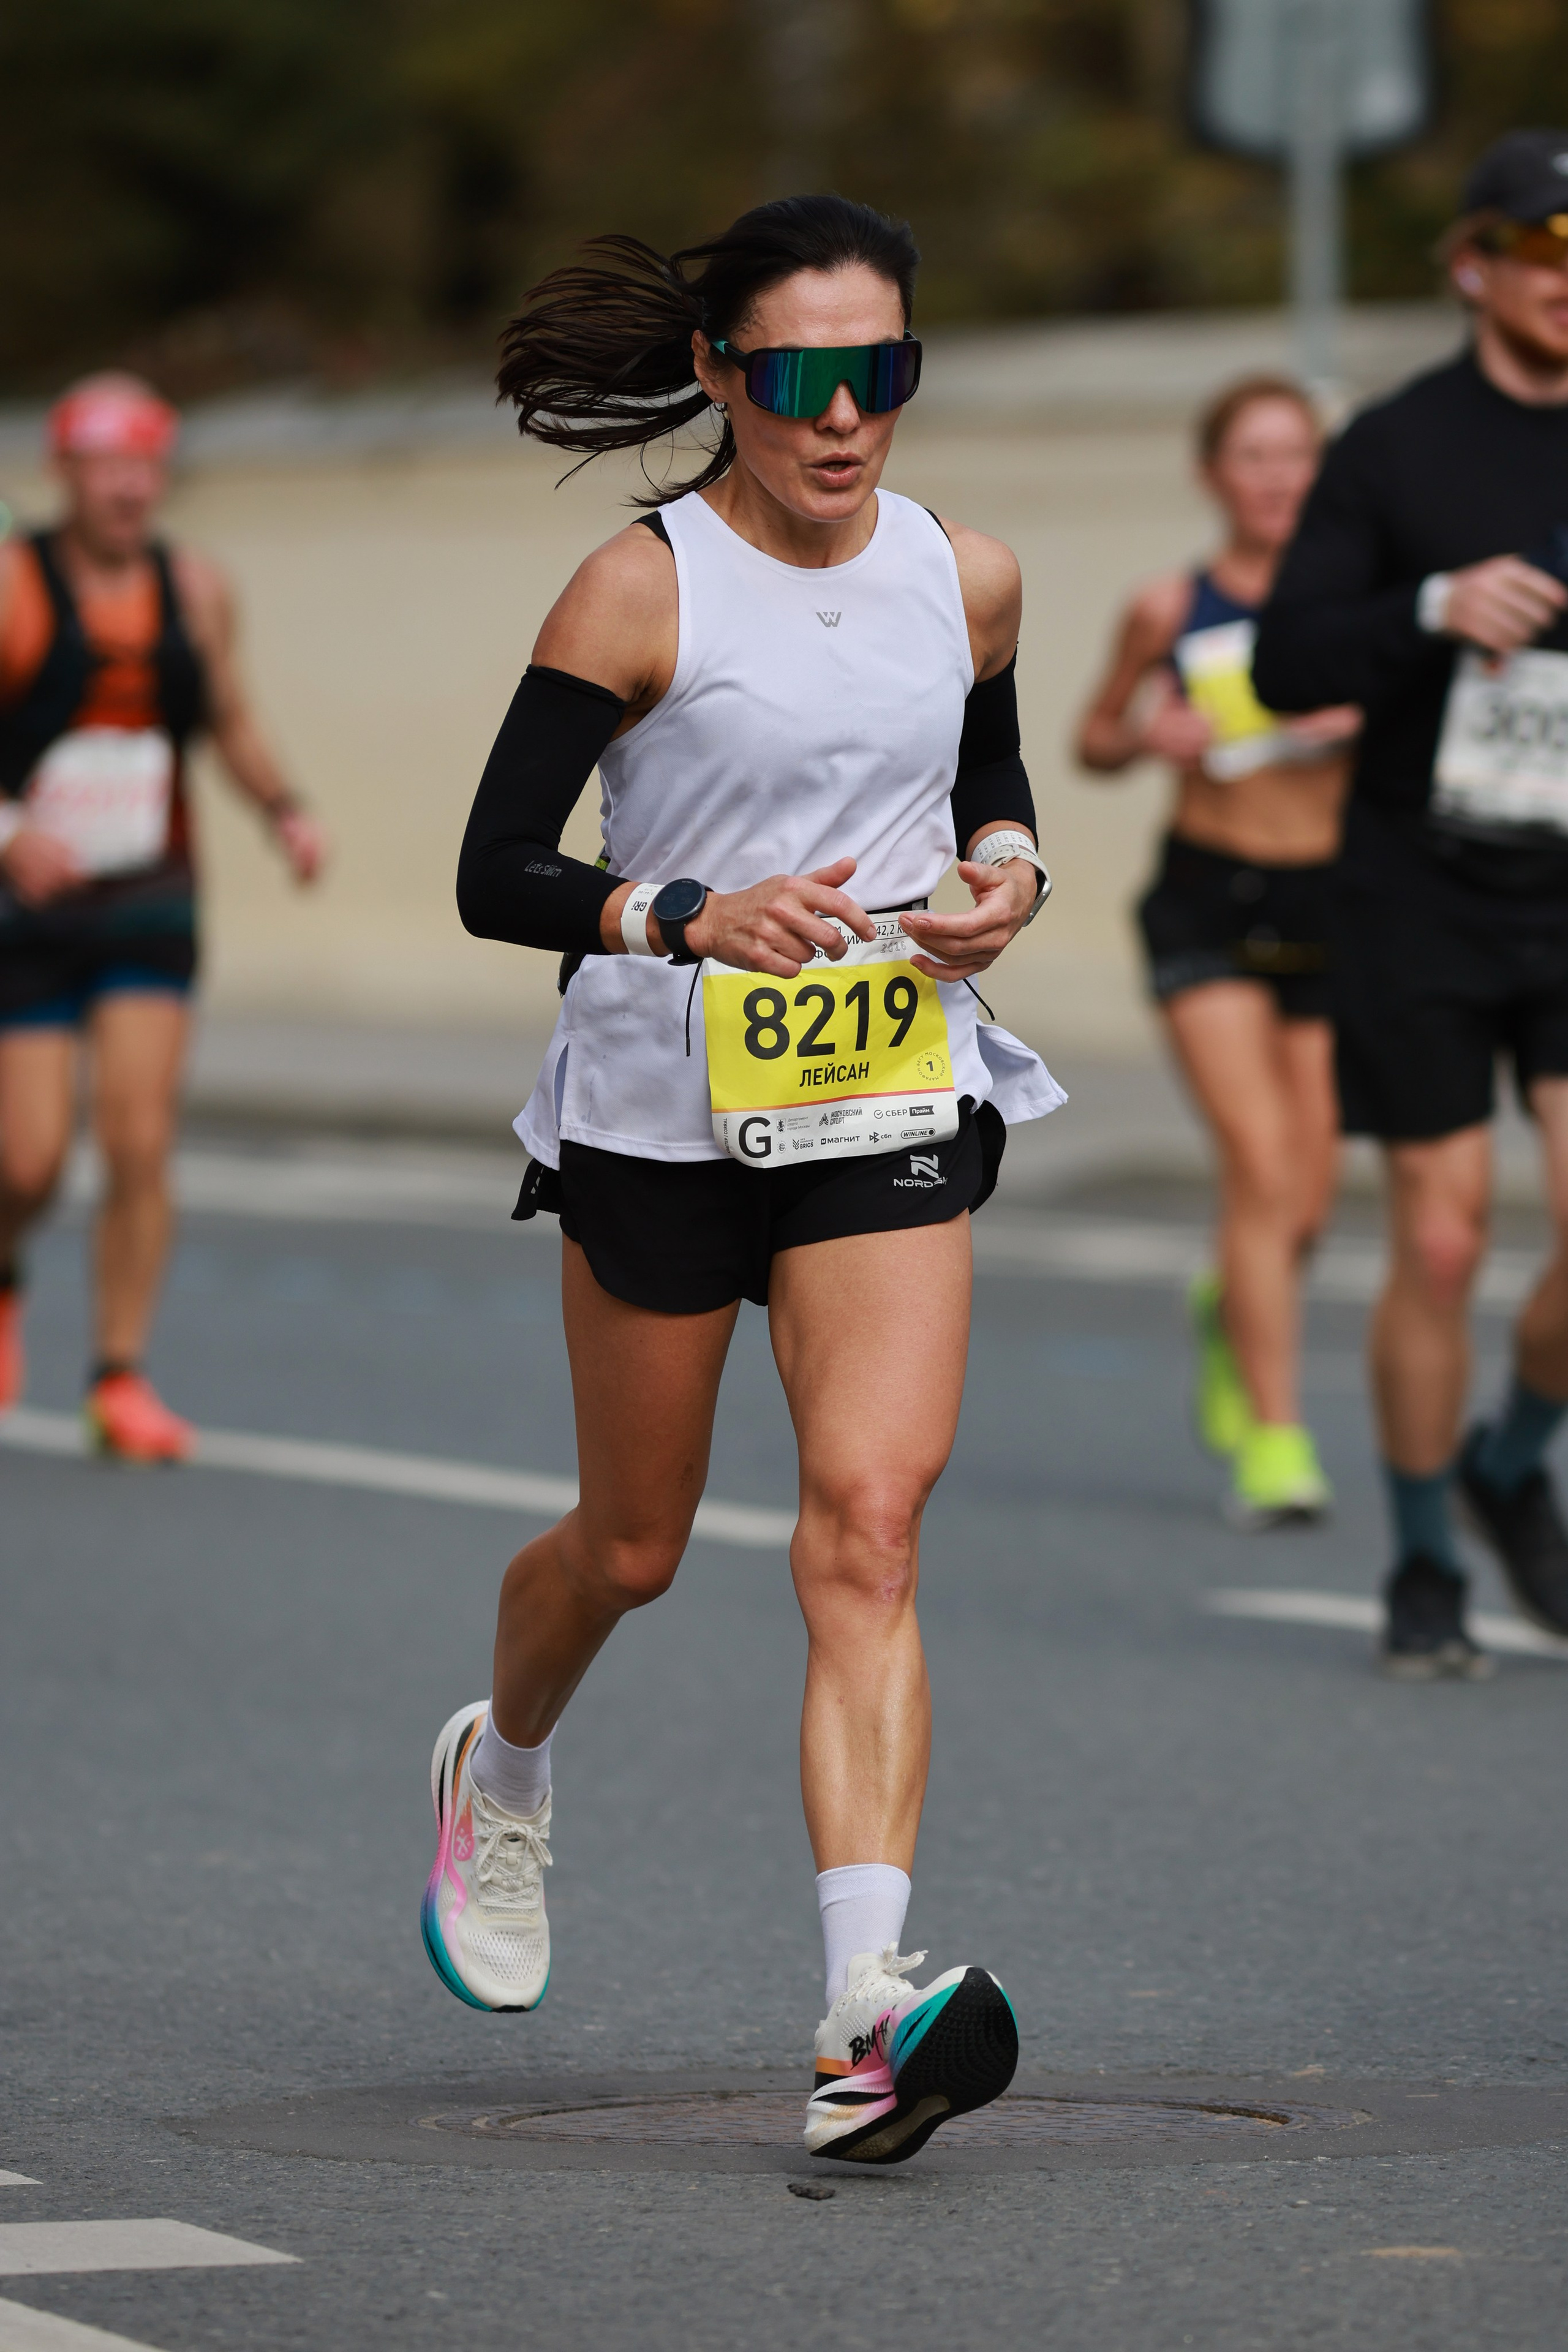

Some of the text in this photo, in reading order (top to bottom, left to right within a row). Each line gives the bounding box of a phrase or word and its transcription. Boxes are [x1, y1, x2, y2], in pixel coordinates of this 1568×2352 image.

[876, 924, 905, 937] 42,2 К
[743, 976, 918, 1060] 8219
[799, 1061, 870, 1087] ЛЕЙСАН
[925, 1061, 933, 1071] 1
[831, 1107, 863, 1118] МОСКОВСКИЙ
[739, 1117, 772, 1158] G
